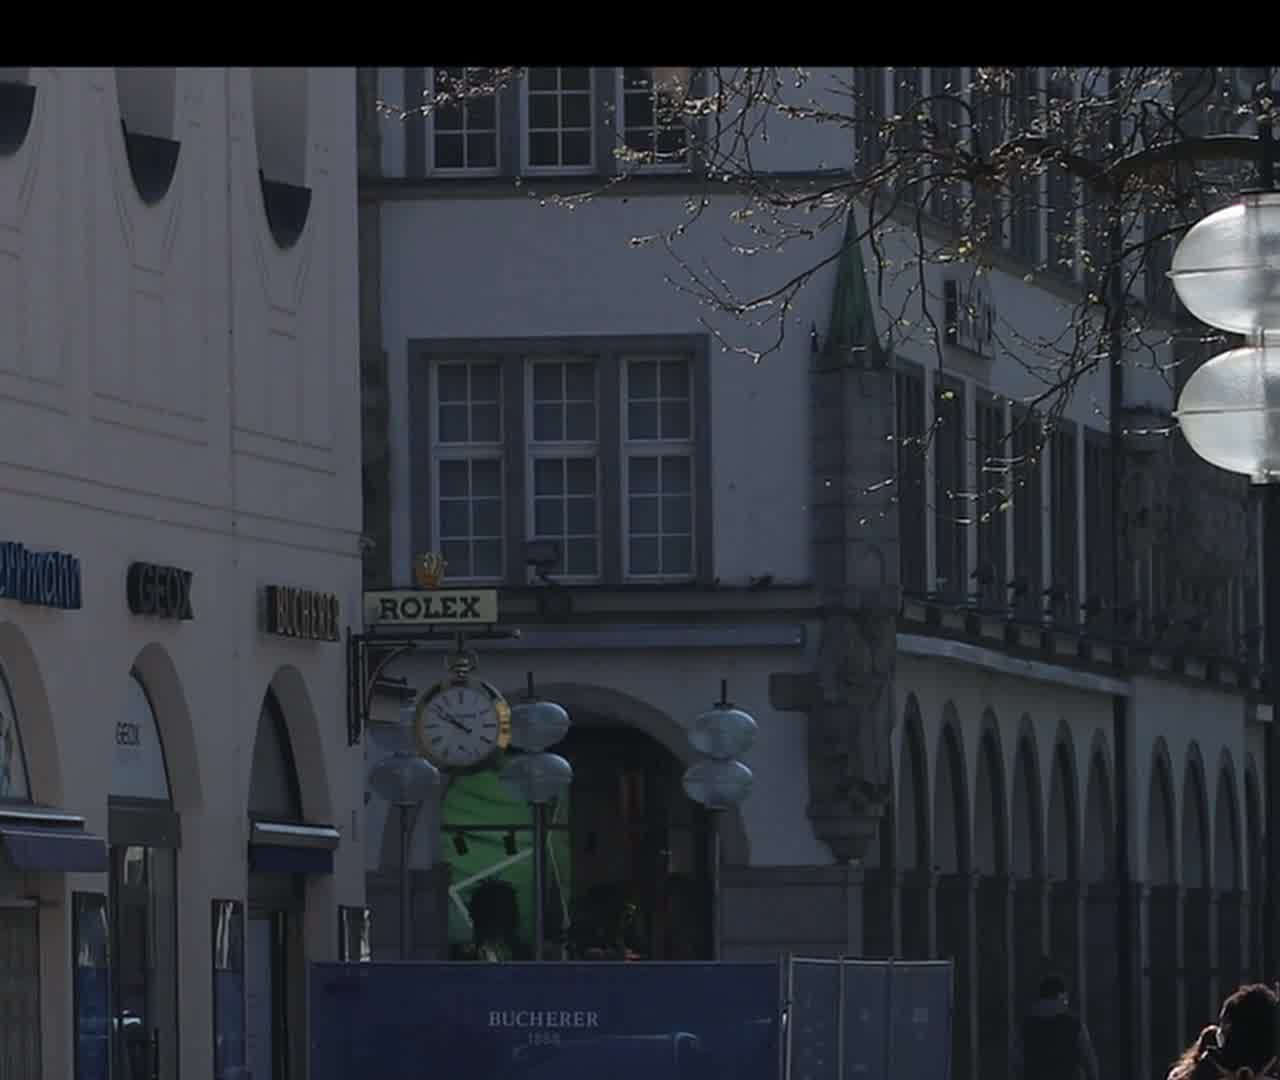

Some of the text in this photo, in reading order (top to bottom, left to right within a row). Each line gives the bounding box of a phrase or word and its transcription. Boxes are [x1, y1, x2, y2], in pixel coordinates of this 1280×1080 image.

[134, 563, 192, 619] GEOX
[378, 596, 481, 620] ROLEX
[488, 1009, 600, 1028] BUCHERER
